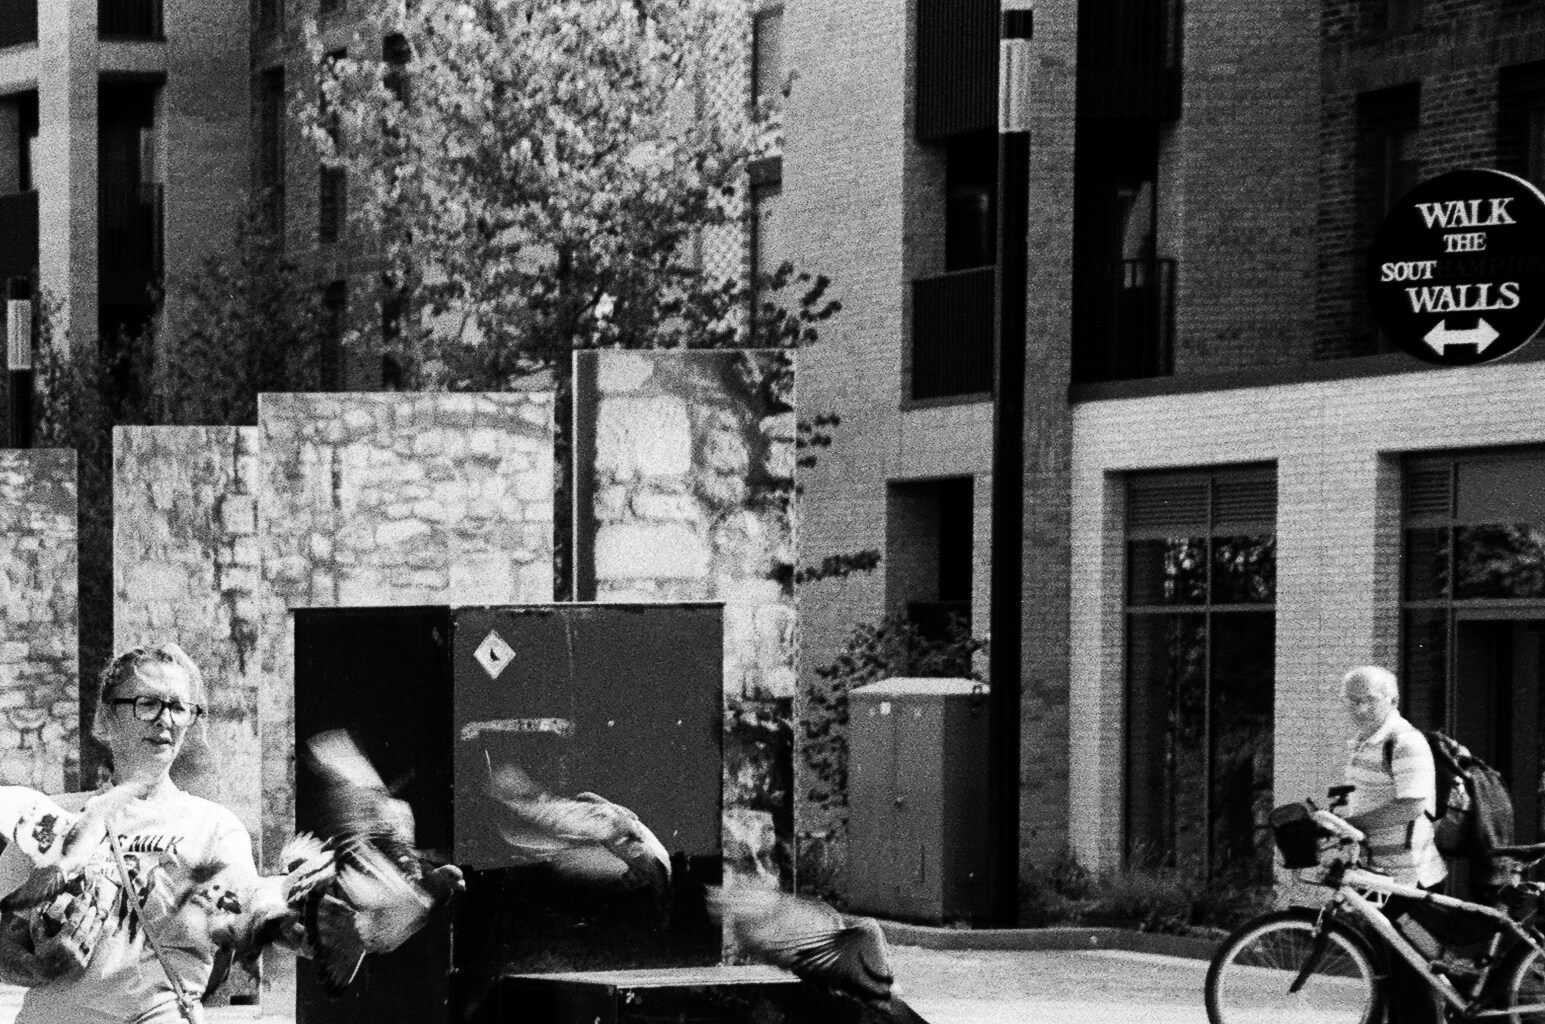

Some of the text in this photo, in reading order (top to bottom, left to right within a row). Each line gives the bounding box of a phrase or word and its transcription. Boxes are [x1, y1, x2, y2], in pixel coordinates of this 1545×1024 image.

[1414, 197, 1516, 229] WALK
[1443, 232, 1487, 253] THE
[1405, 282, 1521, 313] WALLS
[129, 835, 184, 854] MILK
